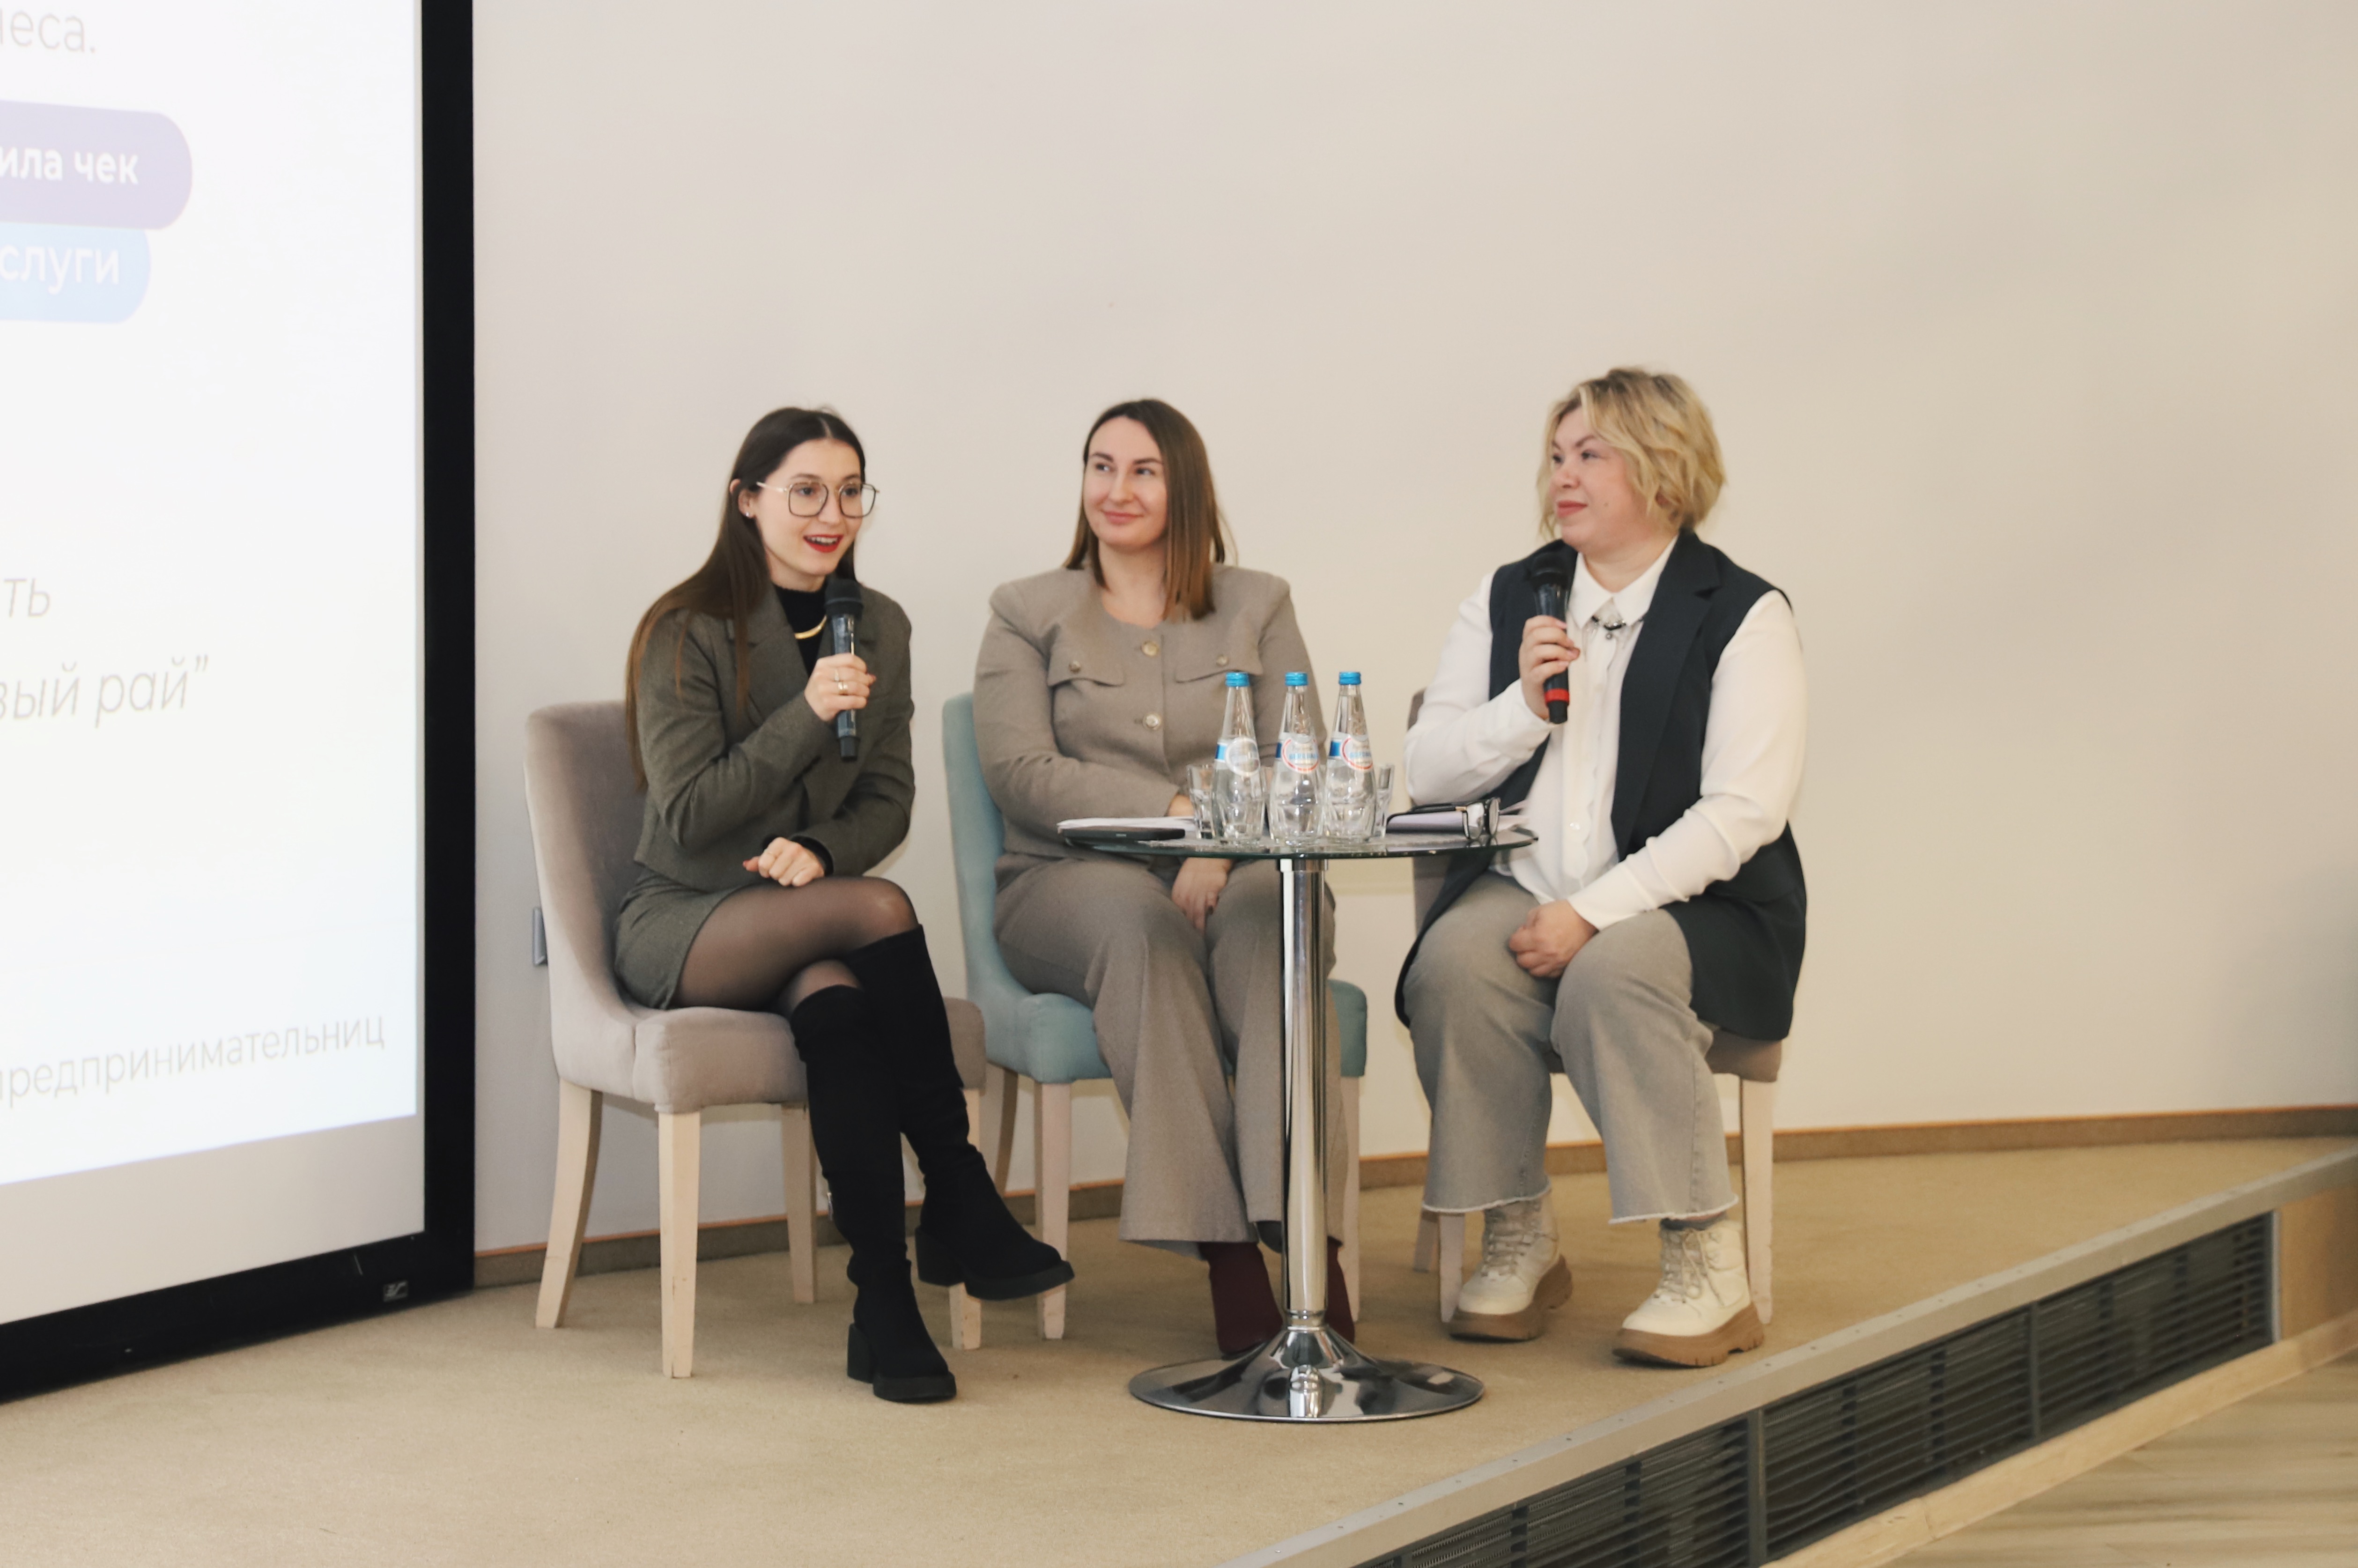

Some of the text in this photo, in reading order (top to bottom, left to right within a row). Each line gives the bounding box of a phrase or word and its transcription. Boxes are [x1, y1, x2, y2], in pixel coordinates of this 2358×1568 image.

[0, 8, 96, 54] еса.
[74, 150, 139, 185] чек
[0, 244, 120, 295] слуги
[4, 577, 51, 618] ть
[0, 1015, 386, 1109] редпринимательниц
